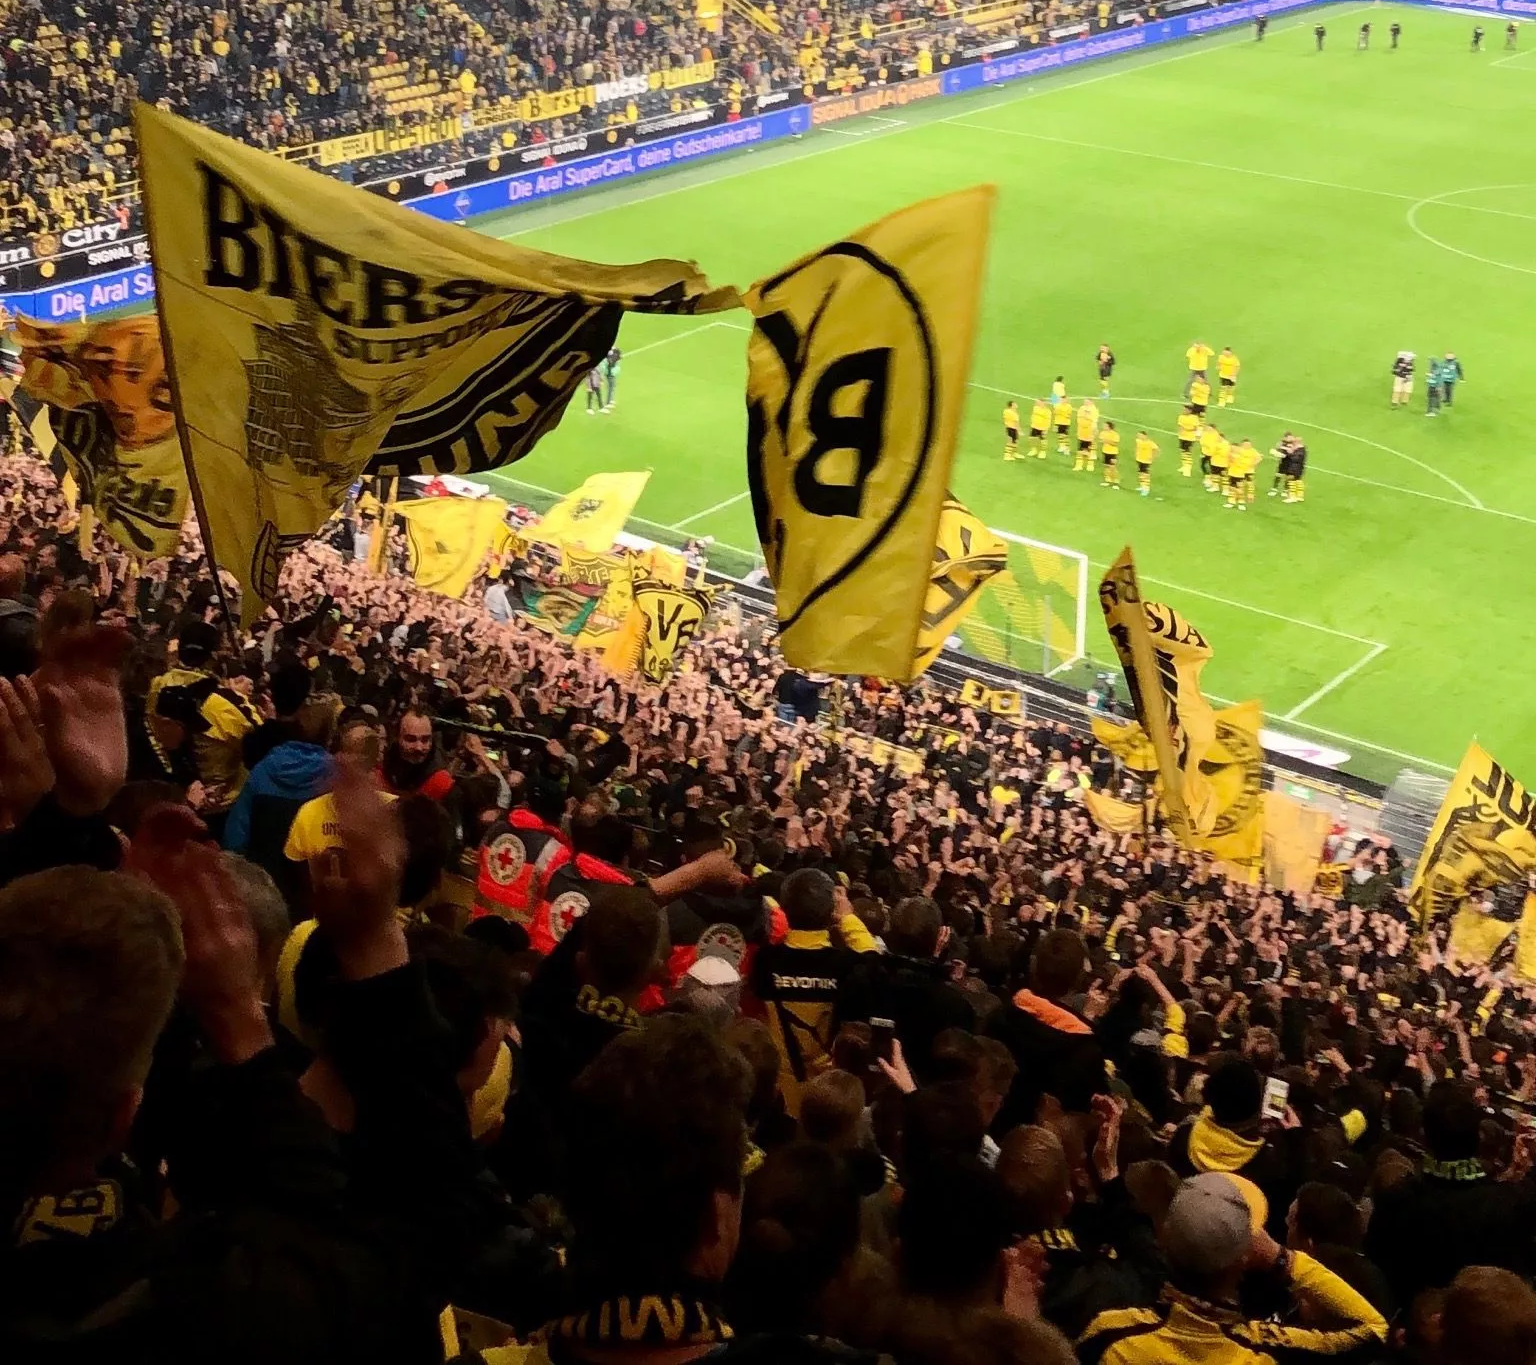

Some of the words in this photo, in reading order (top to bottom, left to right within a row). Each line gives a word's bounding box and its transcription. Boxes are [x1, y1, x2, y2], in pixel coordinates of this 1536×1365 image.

[509, 180, 534, 201] Die
[536, 170, 563, 194] Aral
[565, 152, 636, 186] SuperCard,
[637, 145, 671, 168] deine
[673, 121, 763, 159] Gutscheinkarte!
[61, 223, 120, 248] City
[88, 245, 132, 266] SIGNAL
[197, 159, 495, 330] BIERS
[51, 290, 85, 317] Die
[90, 277, 129, 308] Aral
